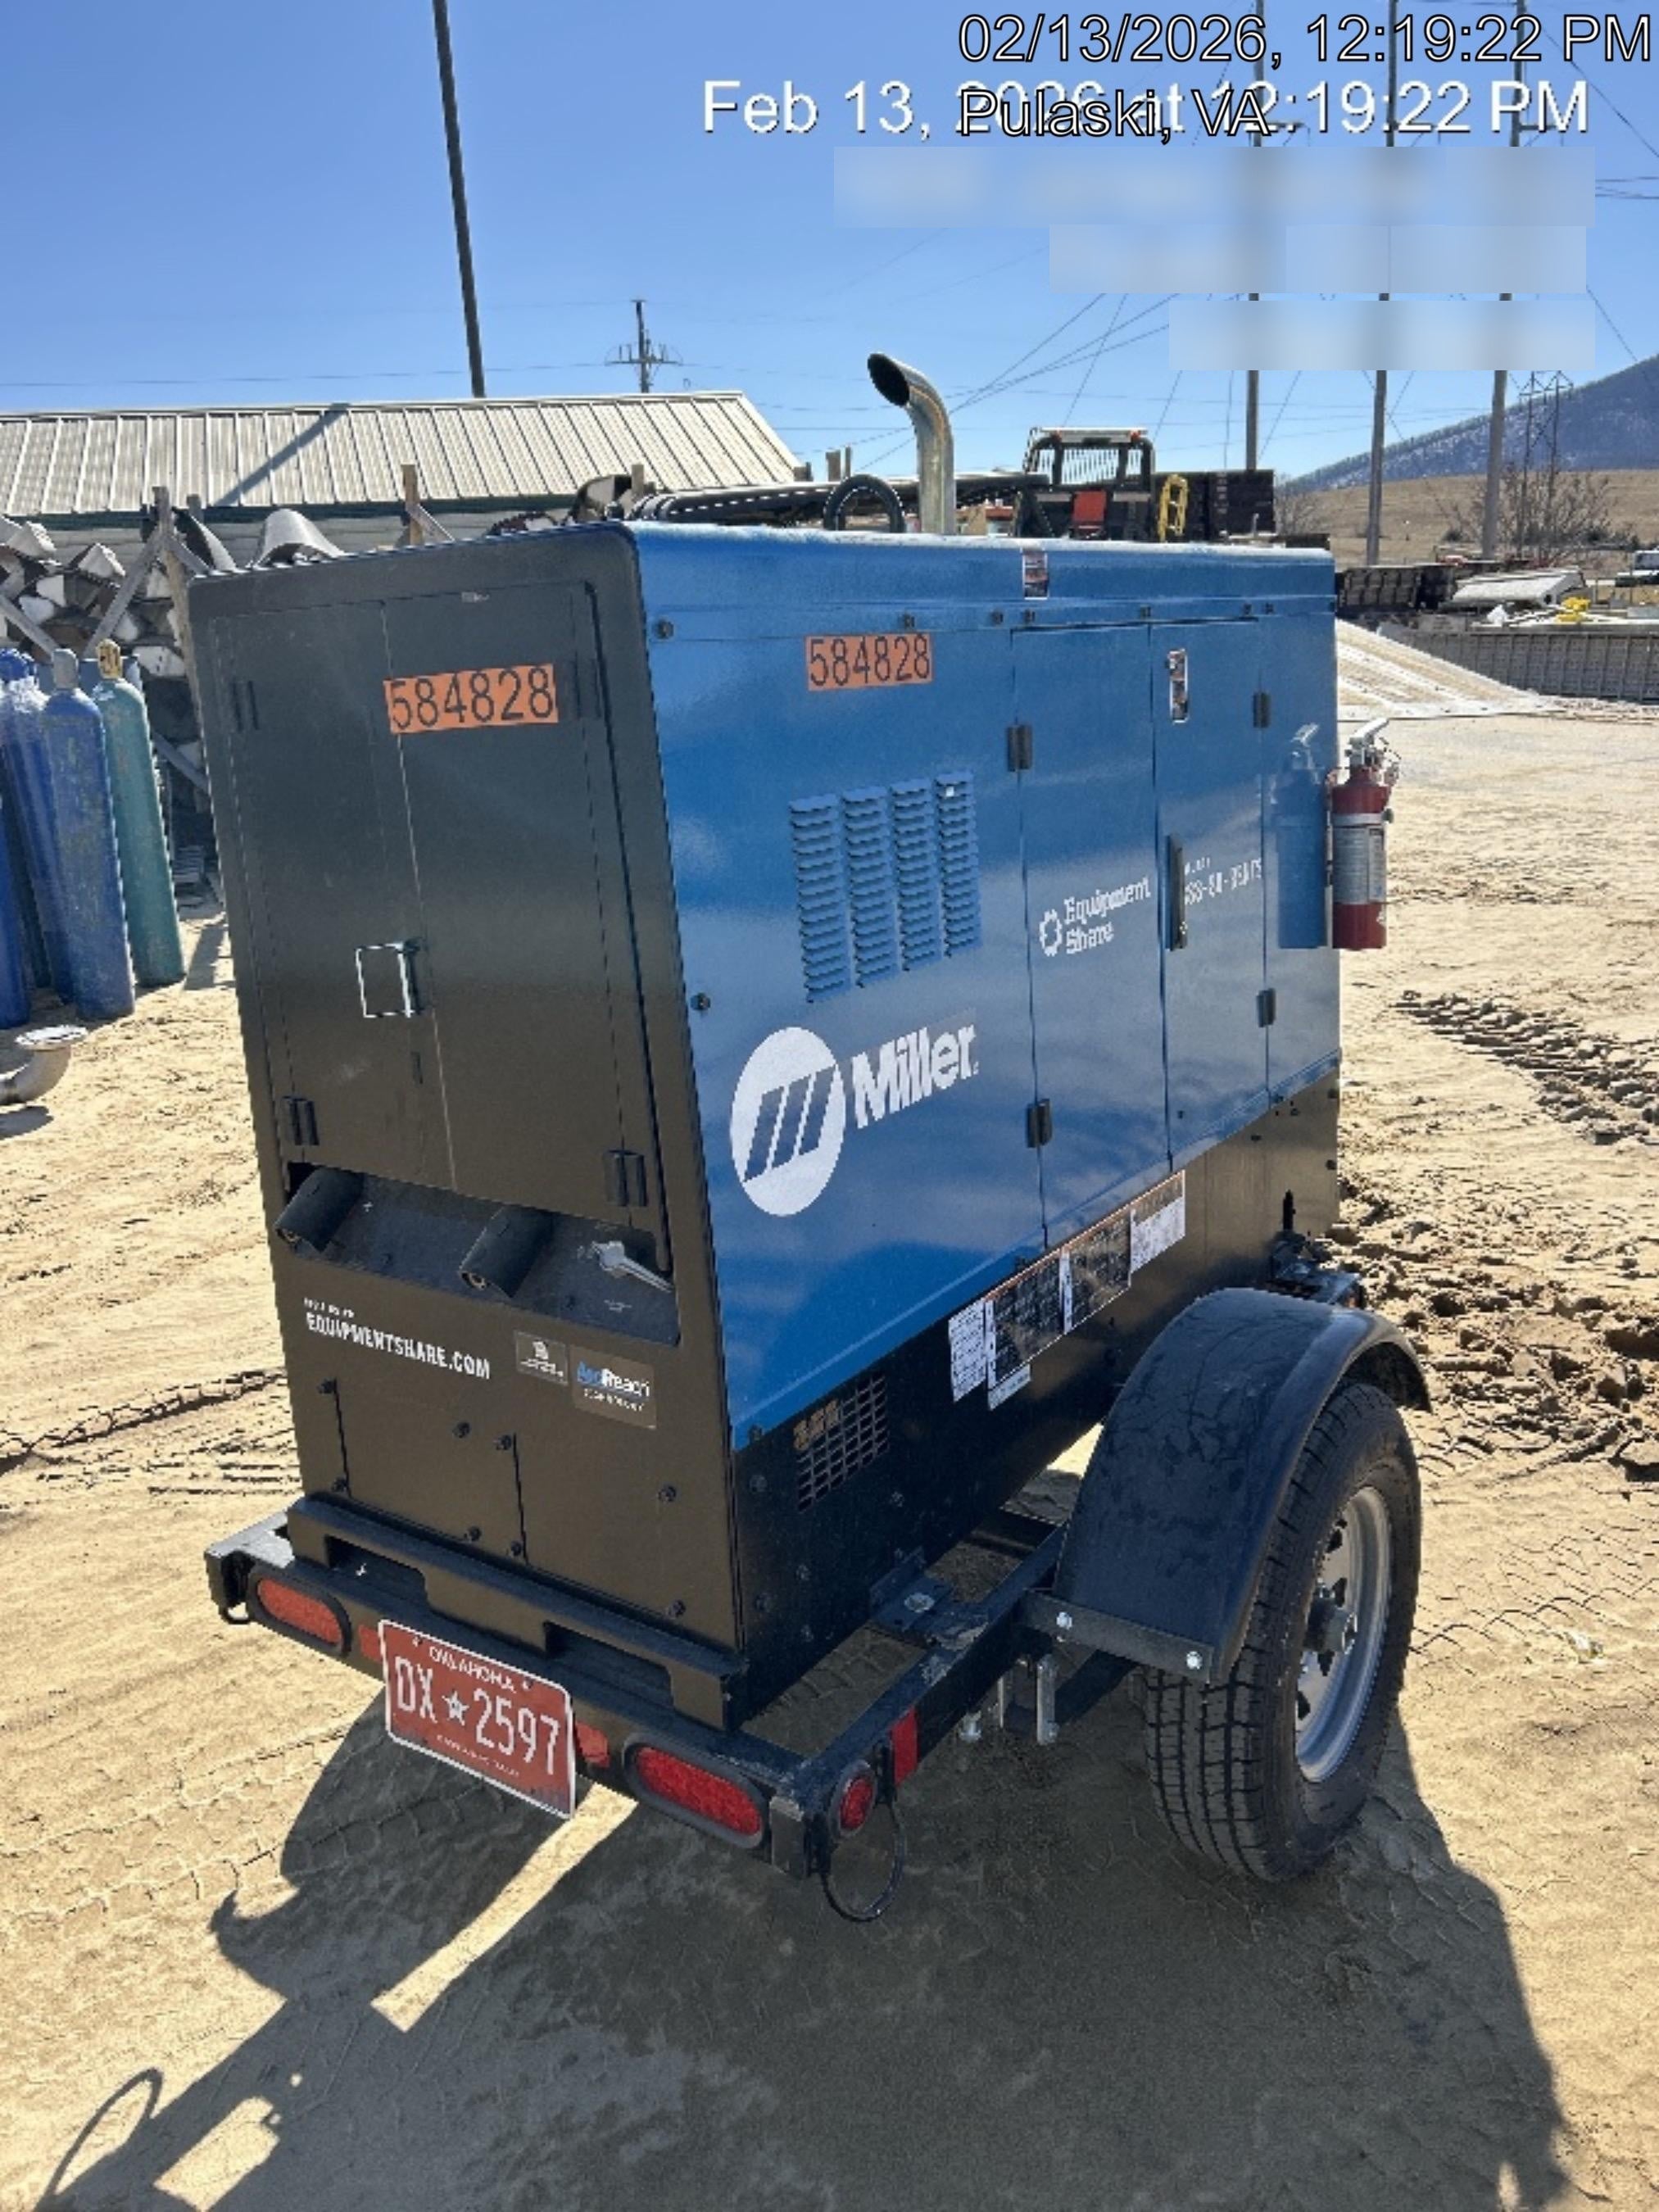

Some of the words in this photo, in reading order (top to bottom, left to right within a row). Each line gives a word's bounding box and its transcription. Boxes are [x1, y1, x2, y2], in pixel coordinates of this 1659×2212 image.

[809, 634, 931, 687] 584828
[389, 666, 555, 729] 584828
[1064, 877, 1151, 924] Equipment
[1066, 922, 1114, 954] Share
[852, 1024, 977, 1129] Miller
[306, 1312, 491, 1380] EQUIPMENTSHARE.COM
[429, 1645, 517, 1693] OKLAHOMA
[395, 1656, 438, 1724] DX
[474, 1688, 560, 1775] 2597
